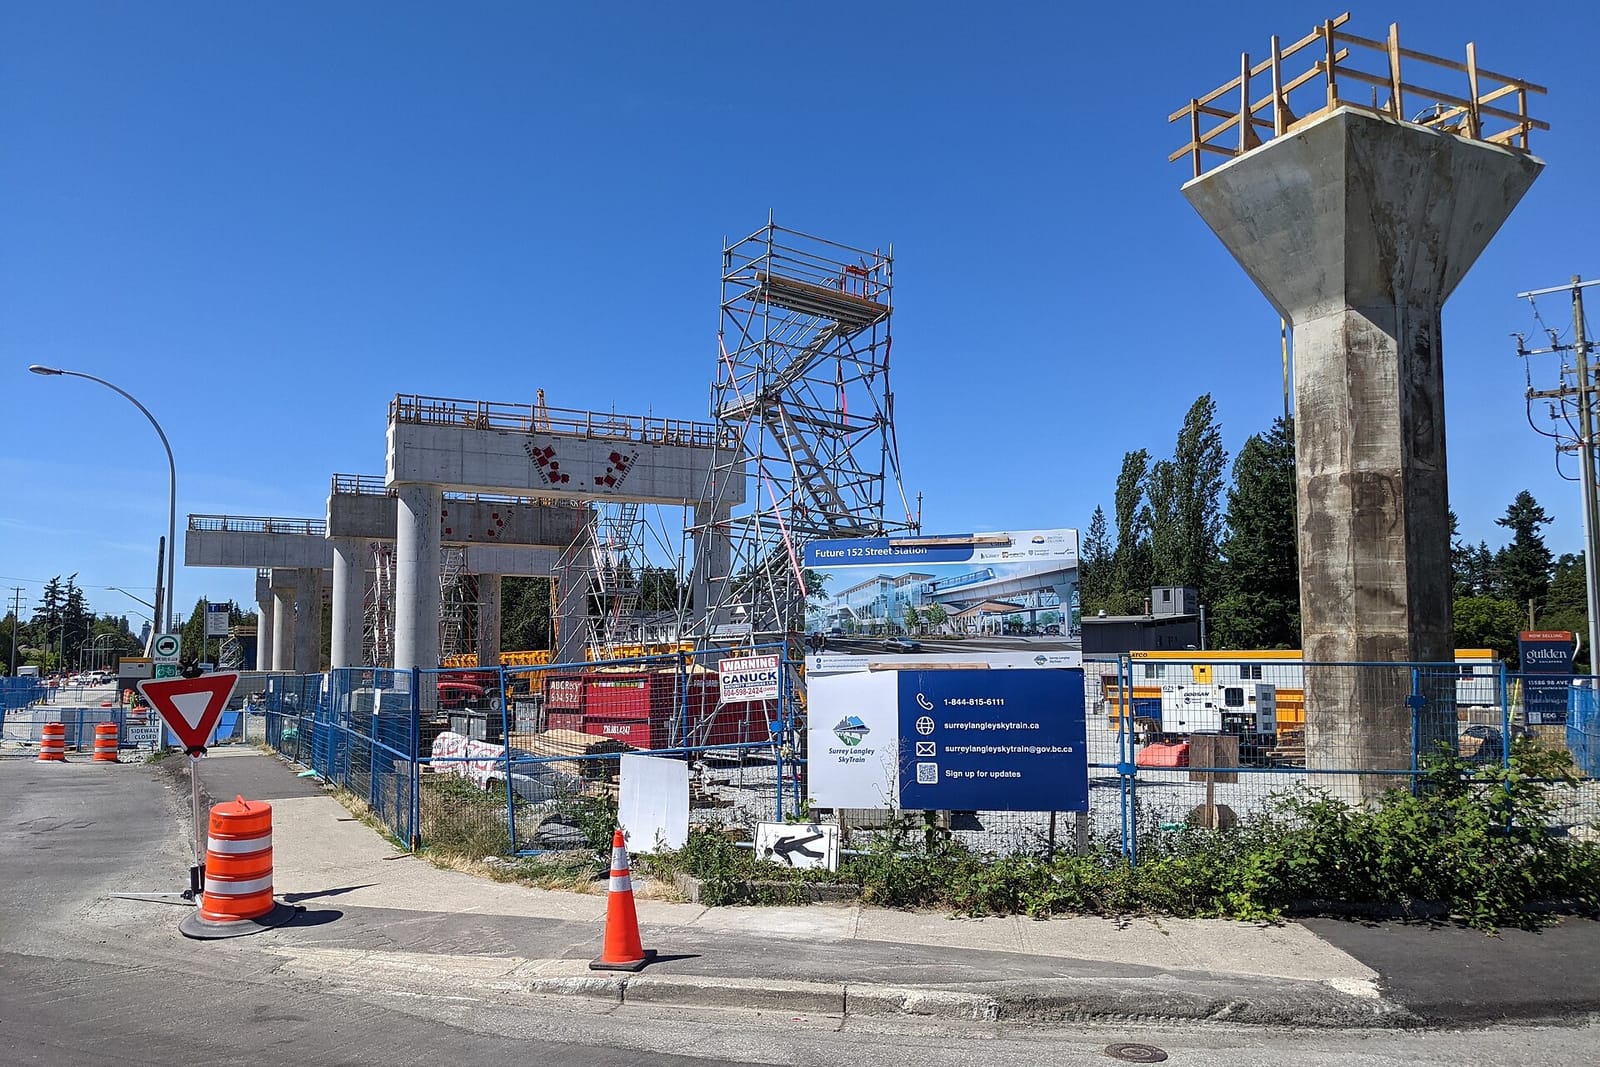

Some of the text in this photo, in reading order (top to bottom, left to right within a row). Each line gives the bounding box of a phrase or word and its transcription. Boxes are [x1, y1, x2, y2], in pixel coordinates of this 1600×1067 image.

[815, 546, 928, 558] Future 152 Street Station
[1526, 648, 1567, 664] guilden
[722, 657, 777, 671] WARNING
[722, 671, 777, 684] CANUCK
[943, 698, 1005, 706] 1-844-815-6111
[943, 721, 1040, 731] surreylangleyskytrain.ca
[828, 747, 875, 756] Surrey Langley
[945, 744, 1073, 754] surreylangleyskytrain@gov.bc.ca
[838, 756, 866, 764] SkyTrain
[945, 769, 1022, 779] Sign up for updates
